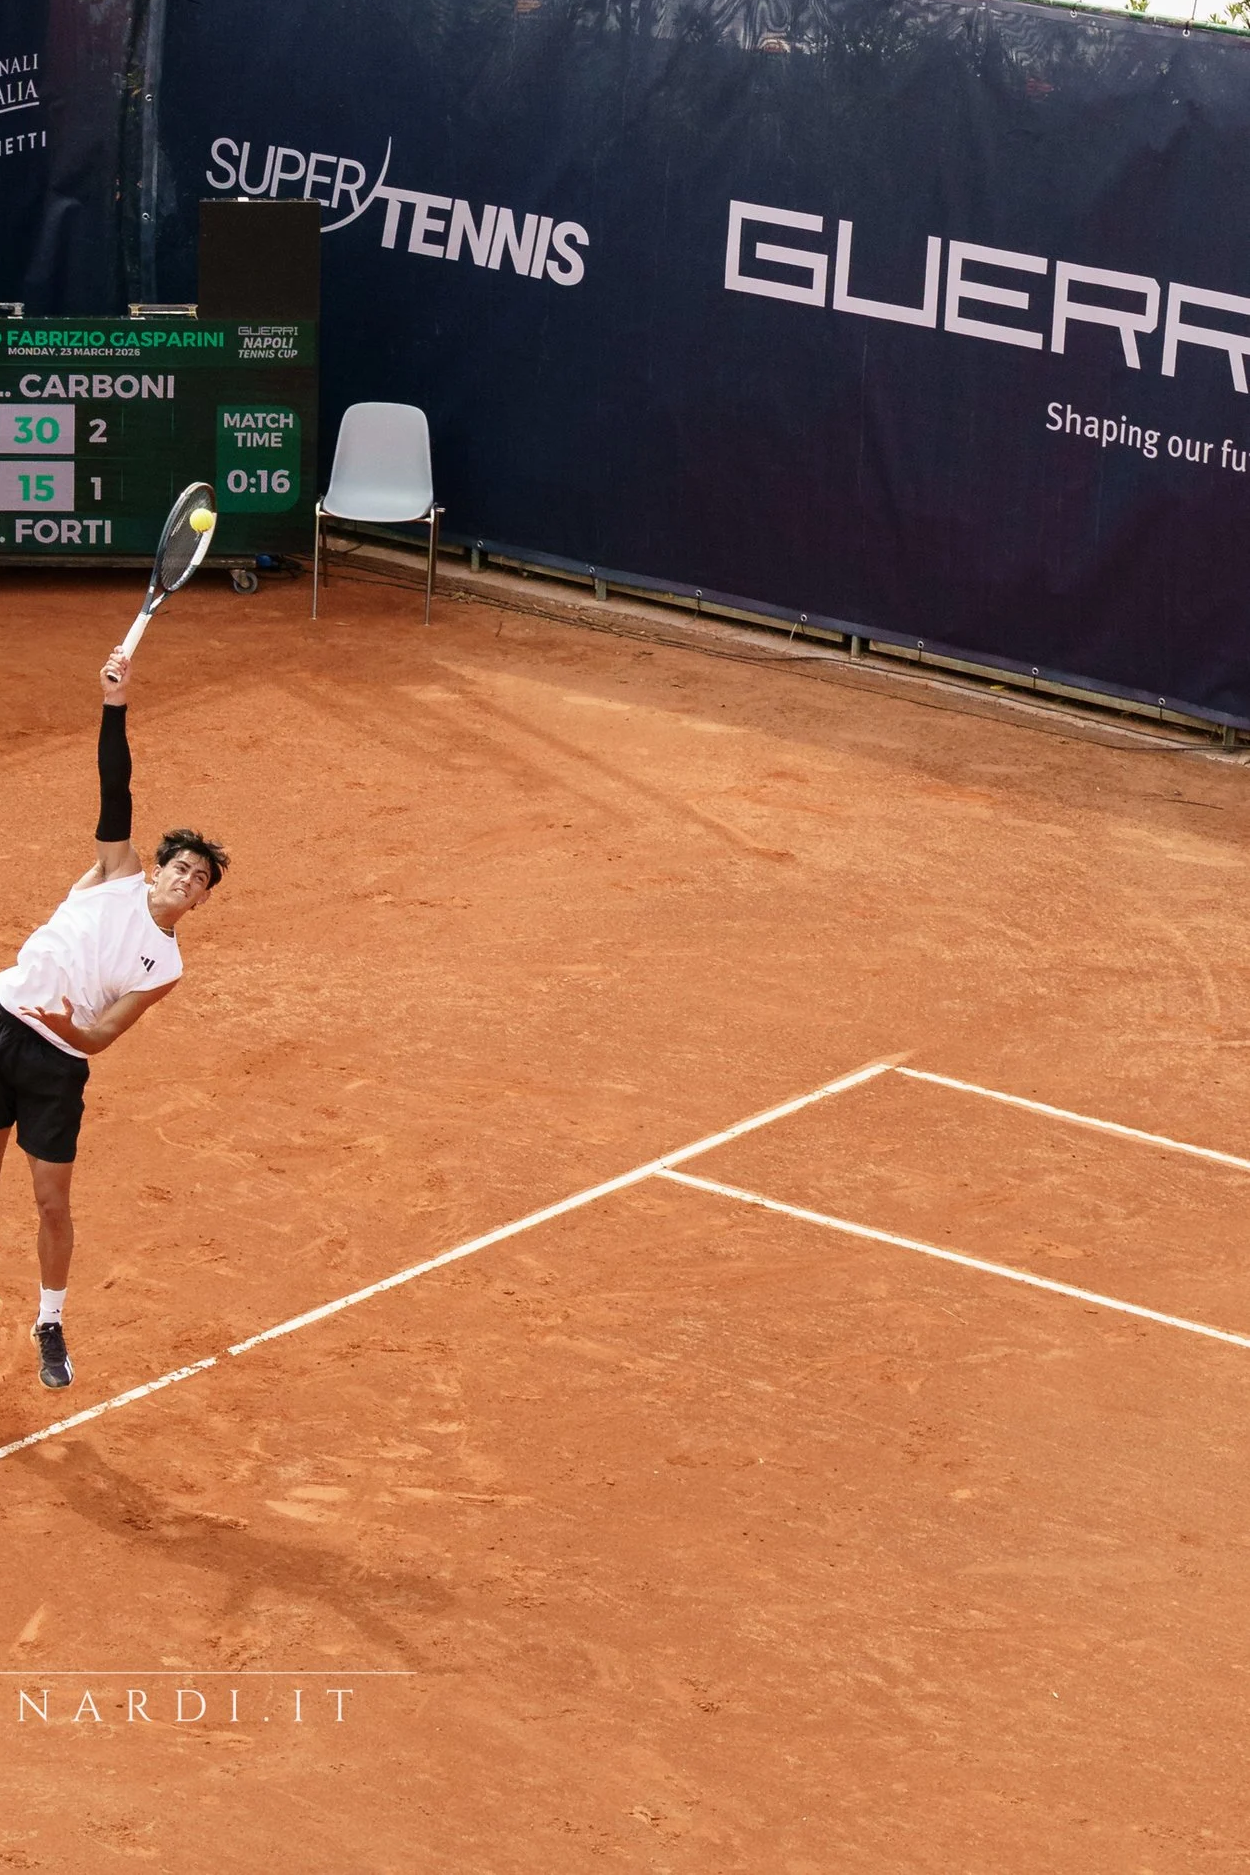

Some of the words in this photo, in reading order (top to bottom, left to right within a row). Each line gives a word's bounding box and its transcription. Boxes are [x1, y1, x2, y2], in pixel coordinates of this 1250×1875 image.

[206, 137, 366, 211] SUPER
[376, 185, 589, 286] TENNIS
[724, 200, 1250, 394] GUERR
[7, 330, 106, 347] FABRIZIO
[110, 331, 225, 348] GASPARINI
[237, 326, 299, 336] GUERRI
[243, 337, 293, 349] NAPOLI
[7, 347, 58, 356] MONDAY,
[60, 347, 72, 356] 23
[73, 347, 113, 356] MARCH
[115, 348, 141, 356] 2026
[237, 349, 275, 358] TENNIS
[277, 349, 298, 359] CUP
[19, 374, 175, 399] CARBONI
[13, 416, 60, 444] 30
[88, 418, 108, 443] 2
[223, 412, 294, 429] MATCH
[233, 432, 283, 448] TIME
[1045, 402, 1161, 459] Shaping
[1167, 435, 1214, 464] our
[1221, 439, 1250, 472] fu
[18, 474, 55, 502] 15
[90, 476, 102, 501] 1
[226, 469, 291, 494] 0:16
[15, 518, 112, 545] FORTI
